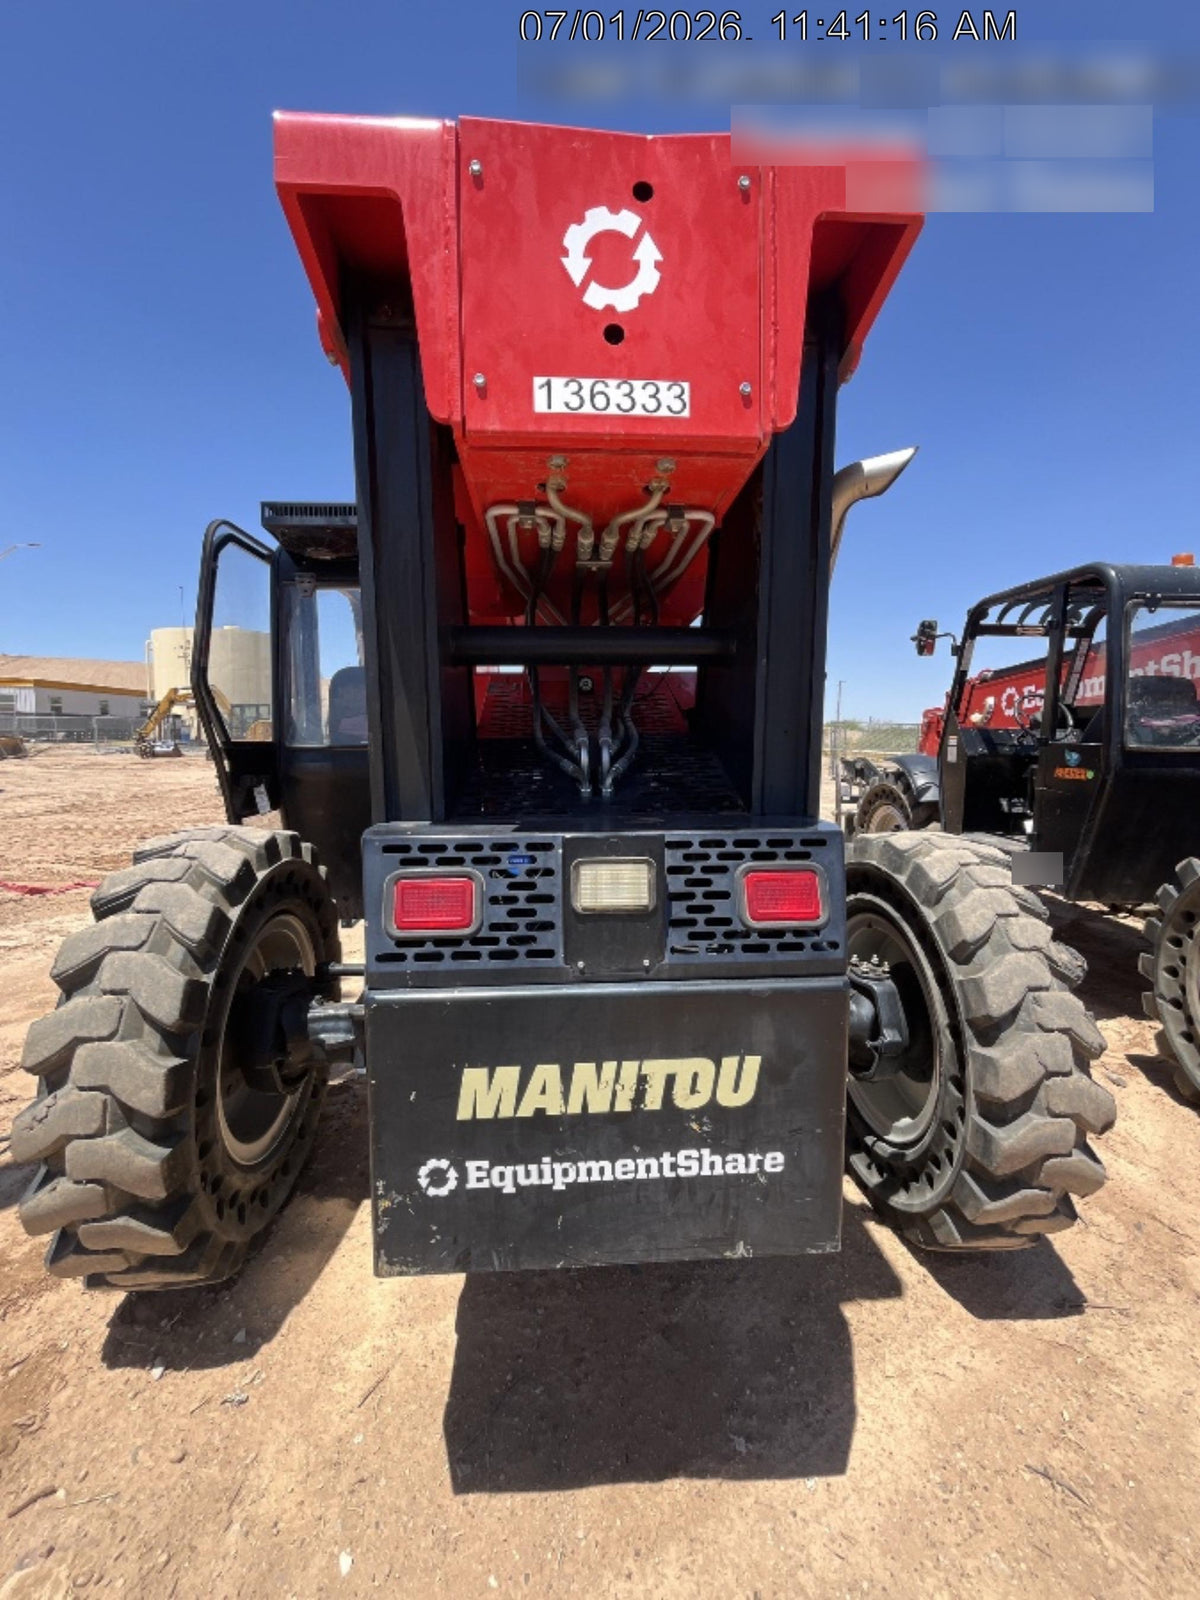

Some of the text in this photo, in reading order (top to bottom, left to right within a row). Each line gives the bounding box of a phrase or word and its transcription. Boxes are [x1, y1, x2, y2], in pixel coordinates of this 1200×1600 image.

[538, 378, 687, 415] 136333
[456, 1055, 762, 1120] MANITOU
[465, 1149, 785, 1193] EquipmentShare
